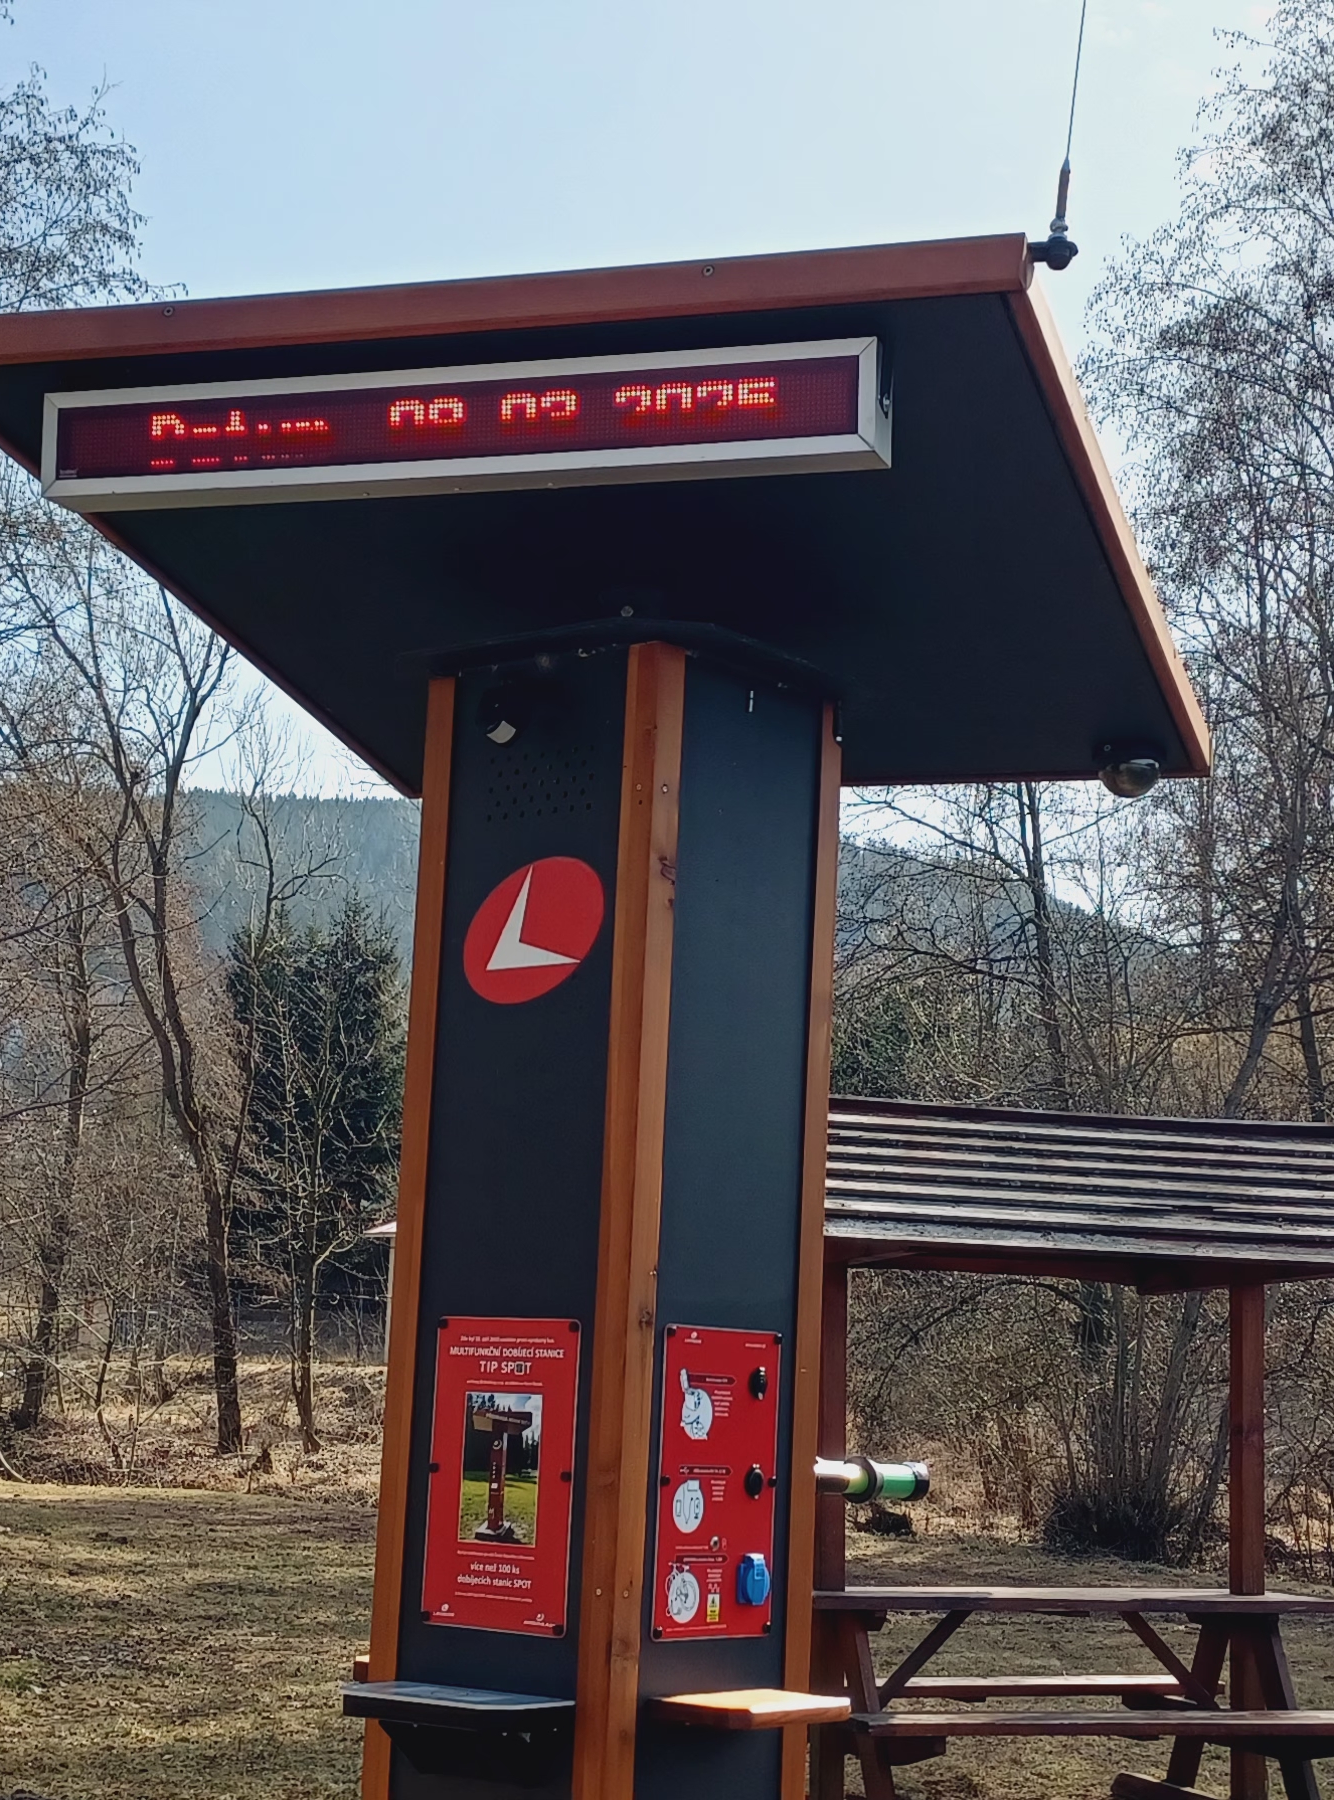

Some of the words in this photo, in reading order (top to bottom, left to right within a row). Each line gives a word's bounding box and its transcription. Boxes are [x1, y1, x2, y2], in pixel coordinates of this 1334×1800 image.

[450, 1346, 501, 1357] MULTIFUNKČNÍ
[535, 1349, 564, 1358] STANICE
[479, 1361, 498, 1373] TIP
[471, 1562, 484, 1571] více
[499, 1564, 511, 1574] 100
[512, 1565, 520, 1574] ks
[493, 1578, 512, 1587] stanic
[513, 1580, 532, 1590] SPOT
